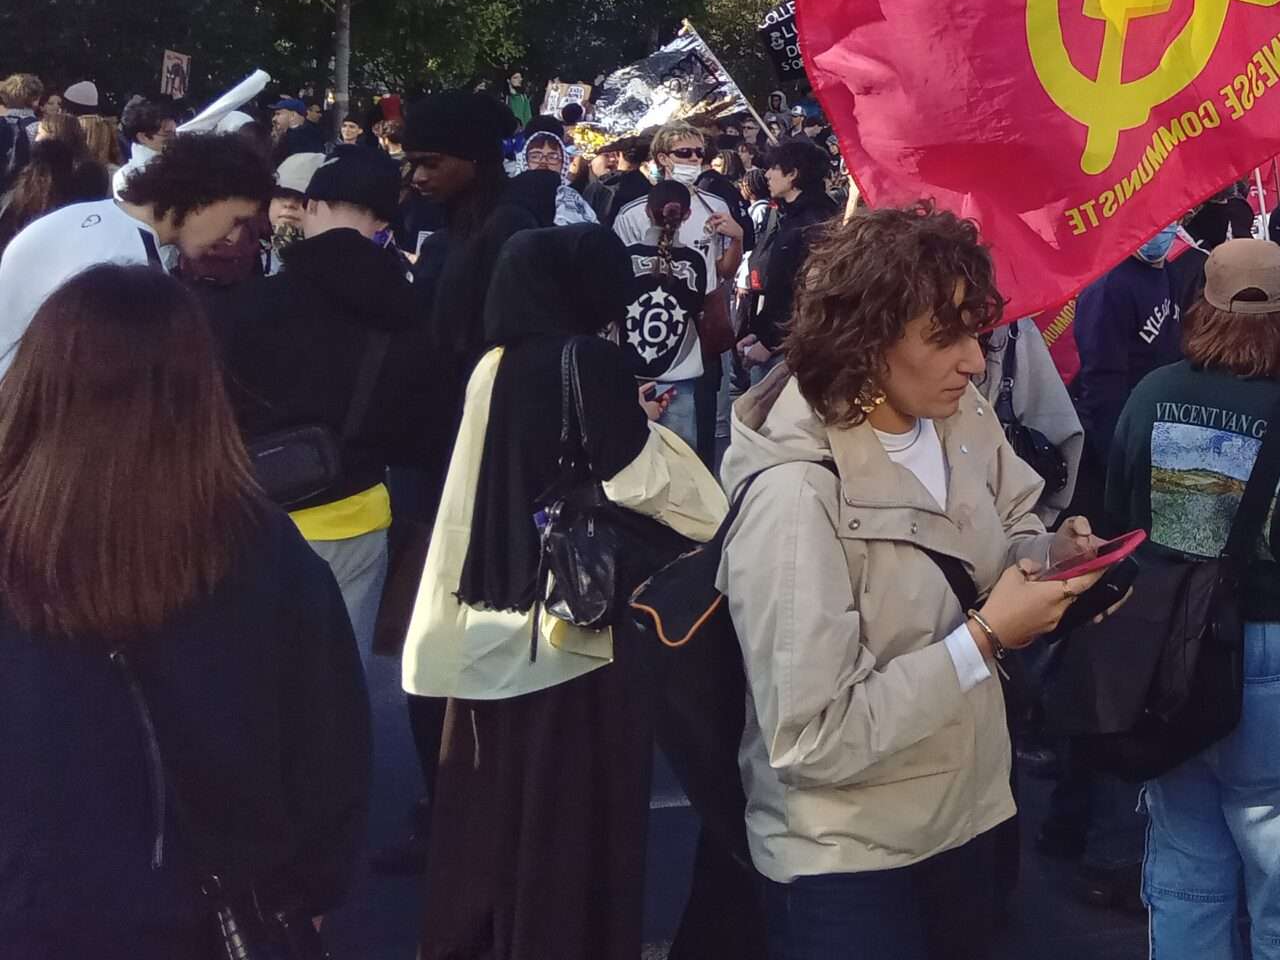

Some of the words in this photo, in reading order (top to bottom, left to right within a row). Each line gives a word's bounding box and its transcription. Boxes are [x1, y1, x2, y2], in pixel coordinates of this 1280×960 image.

[643, 307, 669, 343] 6
[1155, 402, 1220, 429] VINCENT
[1221, 409, 1252, 434] VAN
